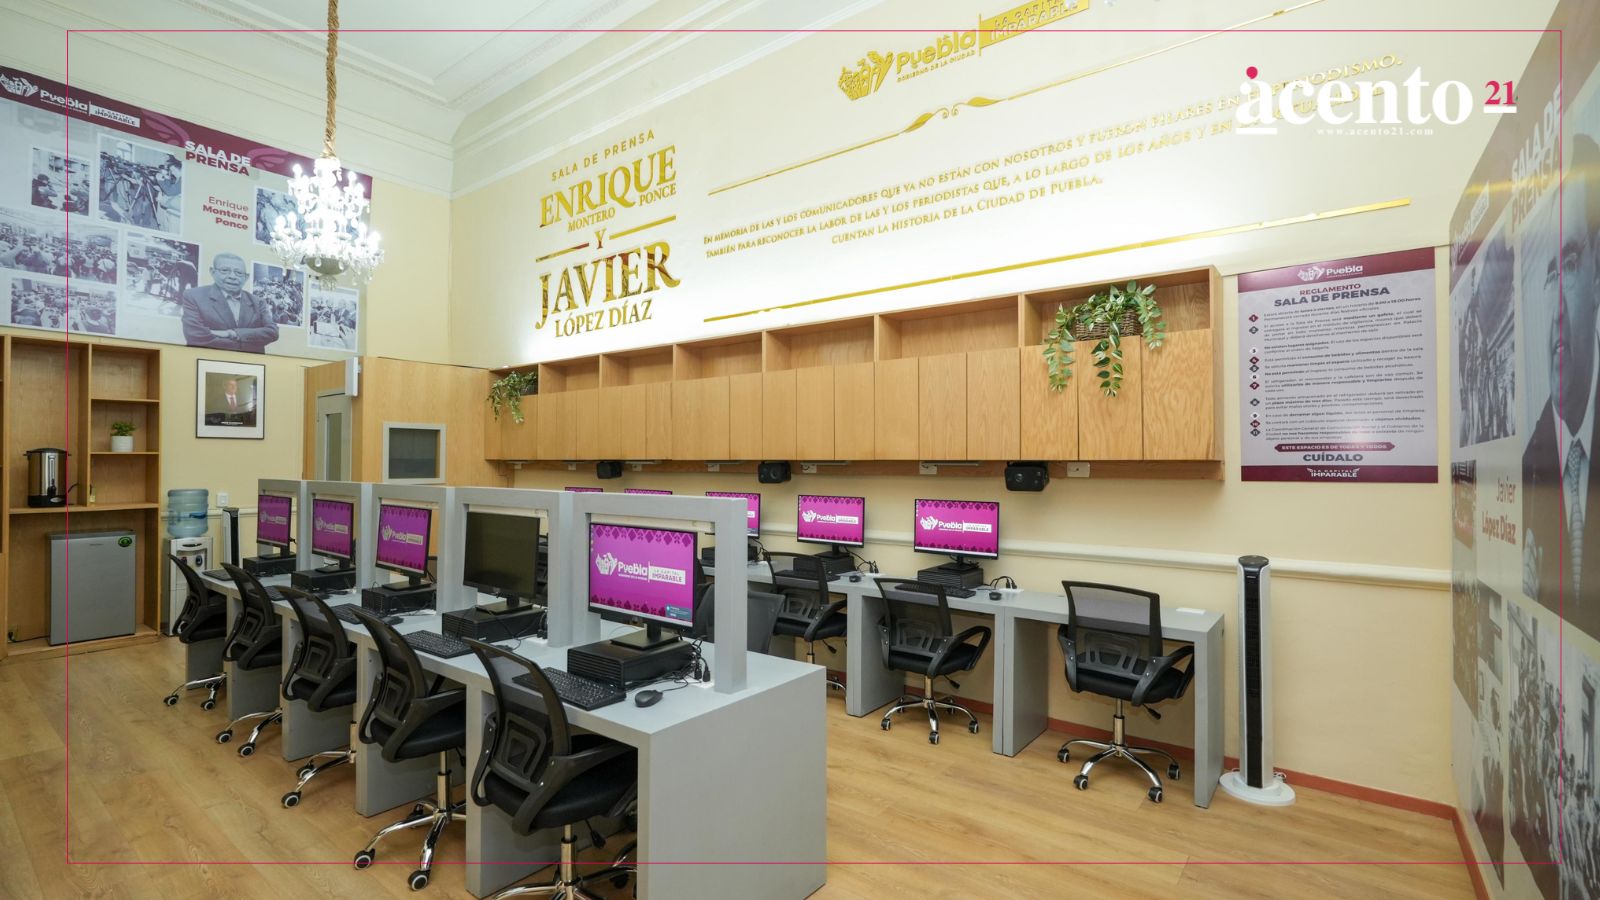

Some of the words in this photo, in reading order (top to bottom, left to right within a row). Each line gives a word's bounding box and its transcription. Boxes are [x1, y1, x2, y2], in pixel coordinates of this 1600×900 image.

[1014, 0, 1064, 19] CAPITA
[896, 29, 976, 75] Puebla
[40, 89, 88, 110] Puebla
[185, 140, 228, 161] SALA
[230, 153, 251, 166] DE
[185, 151, 250, 177] PRENSA
[551, 162, 578, 182] SALA
[583, 153, 598, 168] DE
[604, 129, 655, 159] PRENSA
[539, 144, 677, 228] ENRIQUE
[703, 235, 713, 245] EN
[714, 226, 748, 243] MEMORIA
[750, 223, 760, 233] DE
[761, 218, 775, 230] LAS
[775, 216, 782, 226] Y
[783, 212, 798, 224] LOS
[800, 191, 878, 220] COMUNICADORES
[880, 186, 901, 199] QUE
[903, 182, 916, 193] YA
[918, 176, 935, 189] NO
[938, 165, 971, 184] ESTÁN
[974, 159, 1000, 174] CON
[1003, 139, 1073, 167] NOSOTROS
[1076, 134, 1086, 147] Y
[1088, 120, 1147, 144] FUERON
[1151, 103, 1213, 128] PILARES
[208, 196, 249, 212] Enrique
[706, 244, 736, 259] TAMBIÉN
[737, 239, 756, 251] PARA
[757, 227, 804, 247] RECONOCER
[807, 224, 817, 235] LA
[819, 216, 847, 231] LABOR
[849, 213, 862, 224] DE
[865, 208, 881, 220] LAS
[883, 205, 890, 215] Y
[892, 201, 910, 213] LOS
[912, 183, 980, 208] PERIODISTAS
[983, 175, 1011, 192] QUE,
[1013, 175, 1022, 184] A
[1025, 168, 1041, 181] LO
[1045, 155, 1090, 176] LARGO
[1094, 148, 1112, 164] DE
[1117, 142, 1145, 159] LOS
[1197, 127, 1207, 140] Y
[202, 204, 249, 221] Montero
[567, 206, 616, 233] MONTERO
[639, 183, 677, 206] PONCE
[831, 227, 875, 245] CUENTAN
[878, 223, 889, 234] LA
[891, 211, 941, 232] HISTORIA
[943, 207, 959, 220] DE
[961, 204, 974, 216] LA
[977, 191, 1025, 212] CIUDAD
[1029, 187, 1046, 201] DE
[215, 217, 249, 230] Ponce
[594, 228, 607, 250] Y
[1326, 265, 1363, 276] Puebla
[535, 241, 681, 330] JAVIER
[1274, 297, 1308, 307] SALA
[1311, 293, 1329, 303] DE
[1332, 287, 1390, 301] PRENSA
[1300, 283, 1361, 296] REGLAMENTO
[555, 310, 606, 338] LÓPEZ
[608, 298, 653, 328] DÍAZ
[1303, 452, 1364, 462] CUÍDALO
[1496, 475, 1516, 504] Javier
[938, 521, 962, 529] Puebla
[618, 561, 648, 576] Puebla
